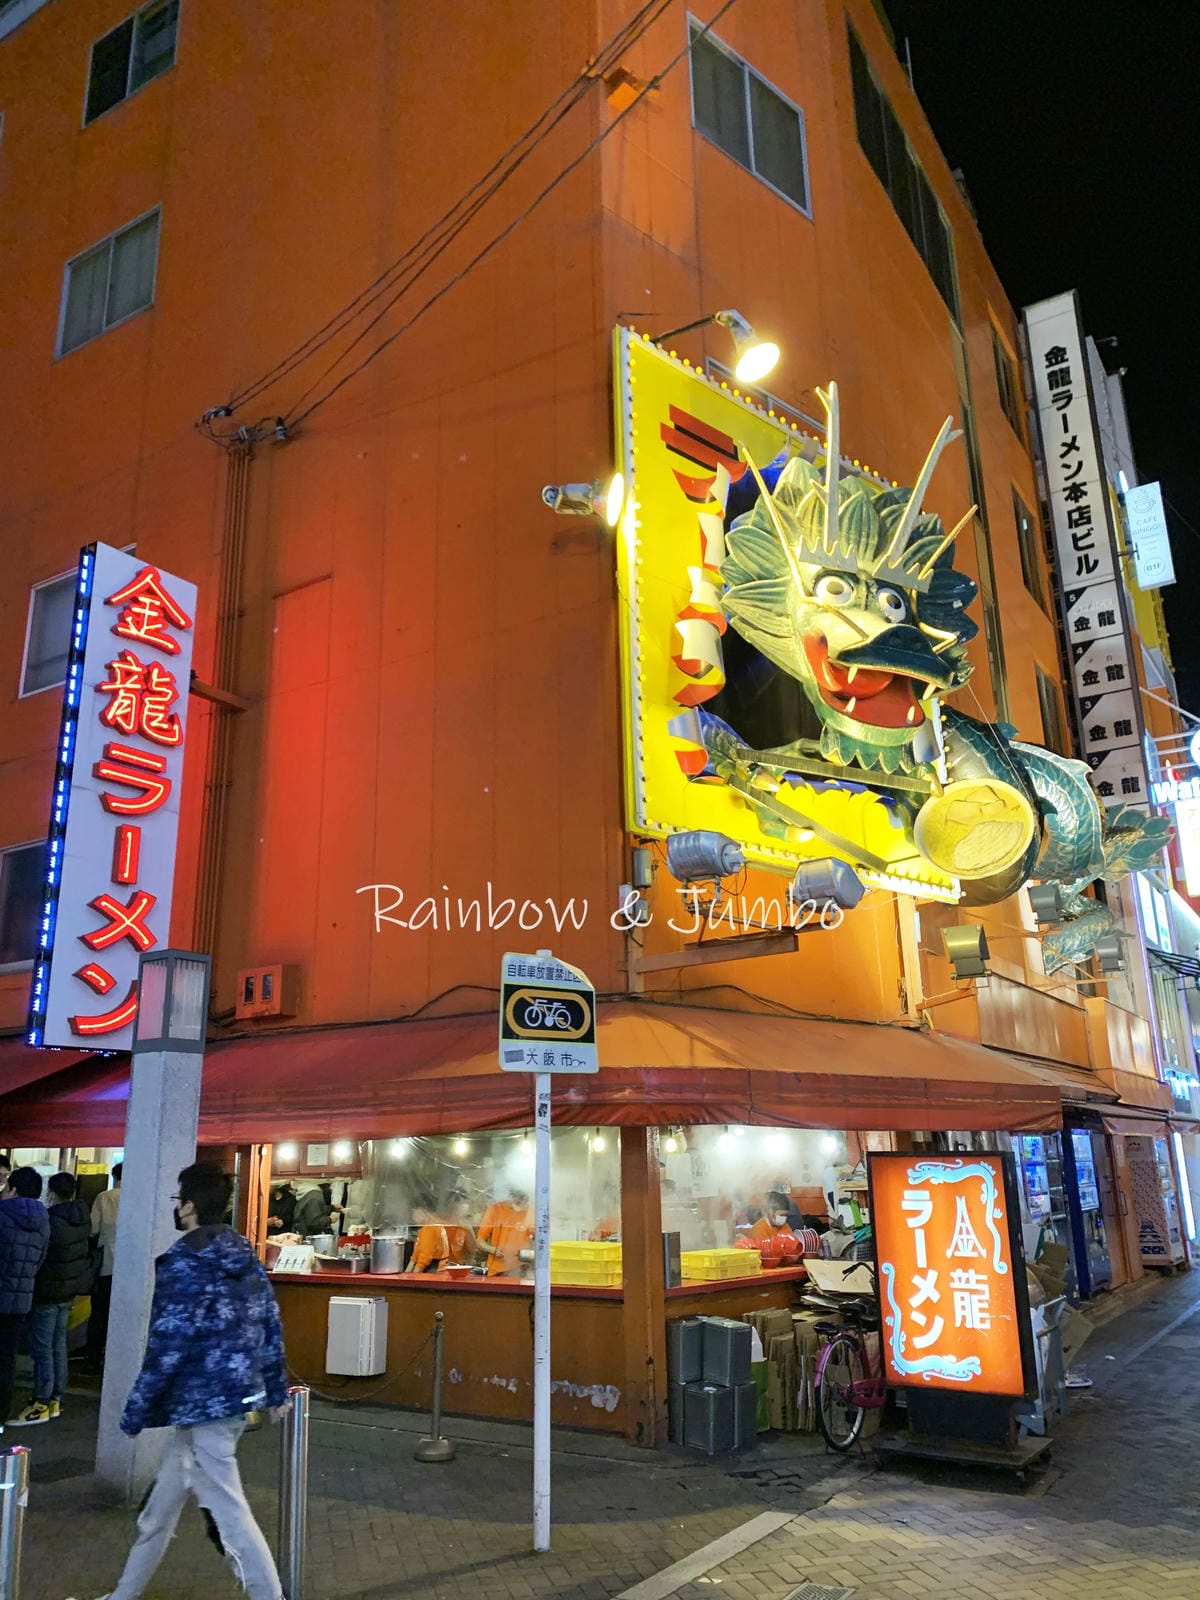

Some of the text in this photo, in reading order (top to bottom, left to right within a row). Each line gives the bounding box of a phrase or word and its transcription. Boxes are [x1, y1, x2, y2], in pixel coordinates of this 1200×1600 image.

[1044, 345, 1099, 577] 金龍ラーメン本店ビル
[1069, 593, 1077, 603] 5
[1074, 609, 1116, 633] 金龍
[1076, 646, 1084, 655] 4
[1082, 663, 1125, 687] 金龍
[1084, 700, 1092, 709] 3
[1088, 719, 1133, 742] 金龍
[1091, 756, 1099, 766] 2
[1097, 776, 1140, 797] 金龍
[67, 565, 193, 1036] 金龍ラーメン
[526, 1050, 573, 1067] 大阪市
[901, 1190, 944, 1349] ラーメン
[946, 1195, 991, 1330] 金龍
